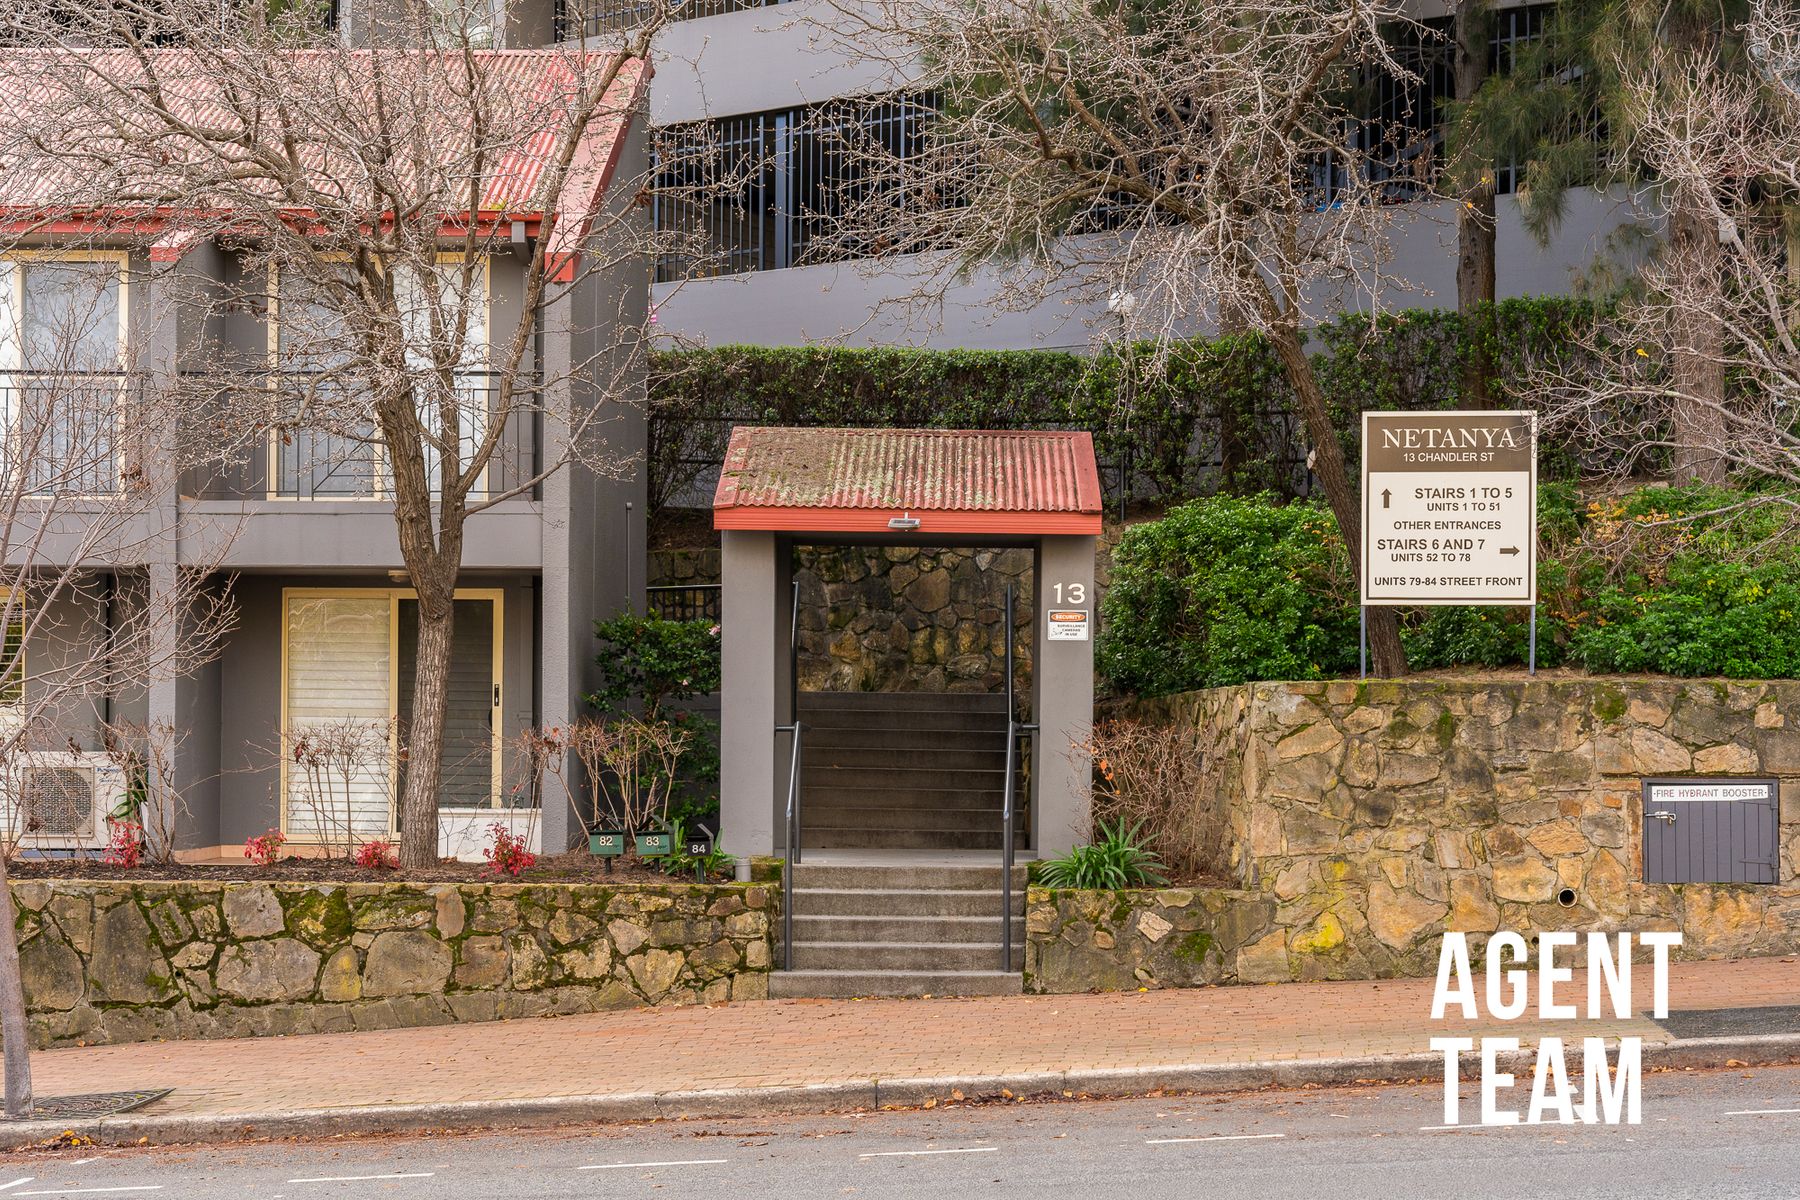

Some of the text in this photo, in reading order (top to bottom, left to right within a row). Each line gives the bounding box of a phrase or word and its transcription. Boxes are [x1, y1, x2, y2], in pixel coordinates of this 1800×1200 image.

[1382, 428, 1517, 449] NETANYA
[1403, 452, 1495, 462] 13 CHANDLER ST
[1414, 487, 1513, 499] STAIRS 1 TO 5
[1427, 503, 1501, 512] UNITS 1 TO 51
[1393, 521, 1502, 530] OTHER ENTRANCES
[1377, 539, 1486, 550] STAIRS 6 AND 7
[1391, 553, 1471, 562] UNITS 52 TO 78
[1374, 577, 1523, 586] UNITS 79-84 STREET FRONT
[1053, 582, 1086, 604] 13
[1656, 788, 1764, 798] FIRE HYDRANT BOOSTER
[599, 836, 613, 846] 82
[646, 836, 659, 846] 83
[692, 844, 706, 854] 84
